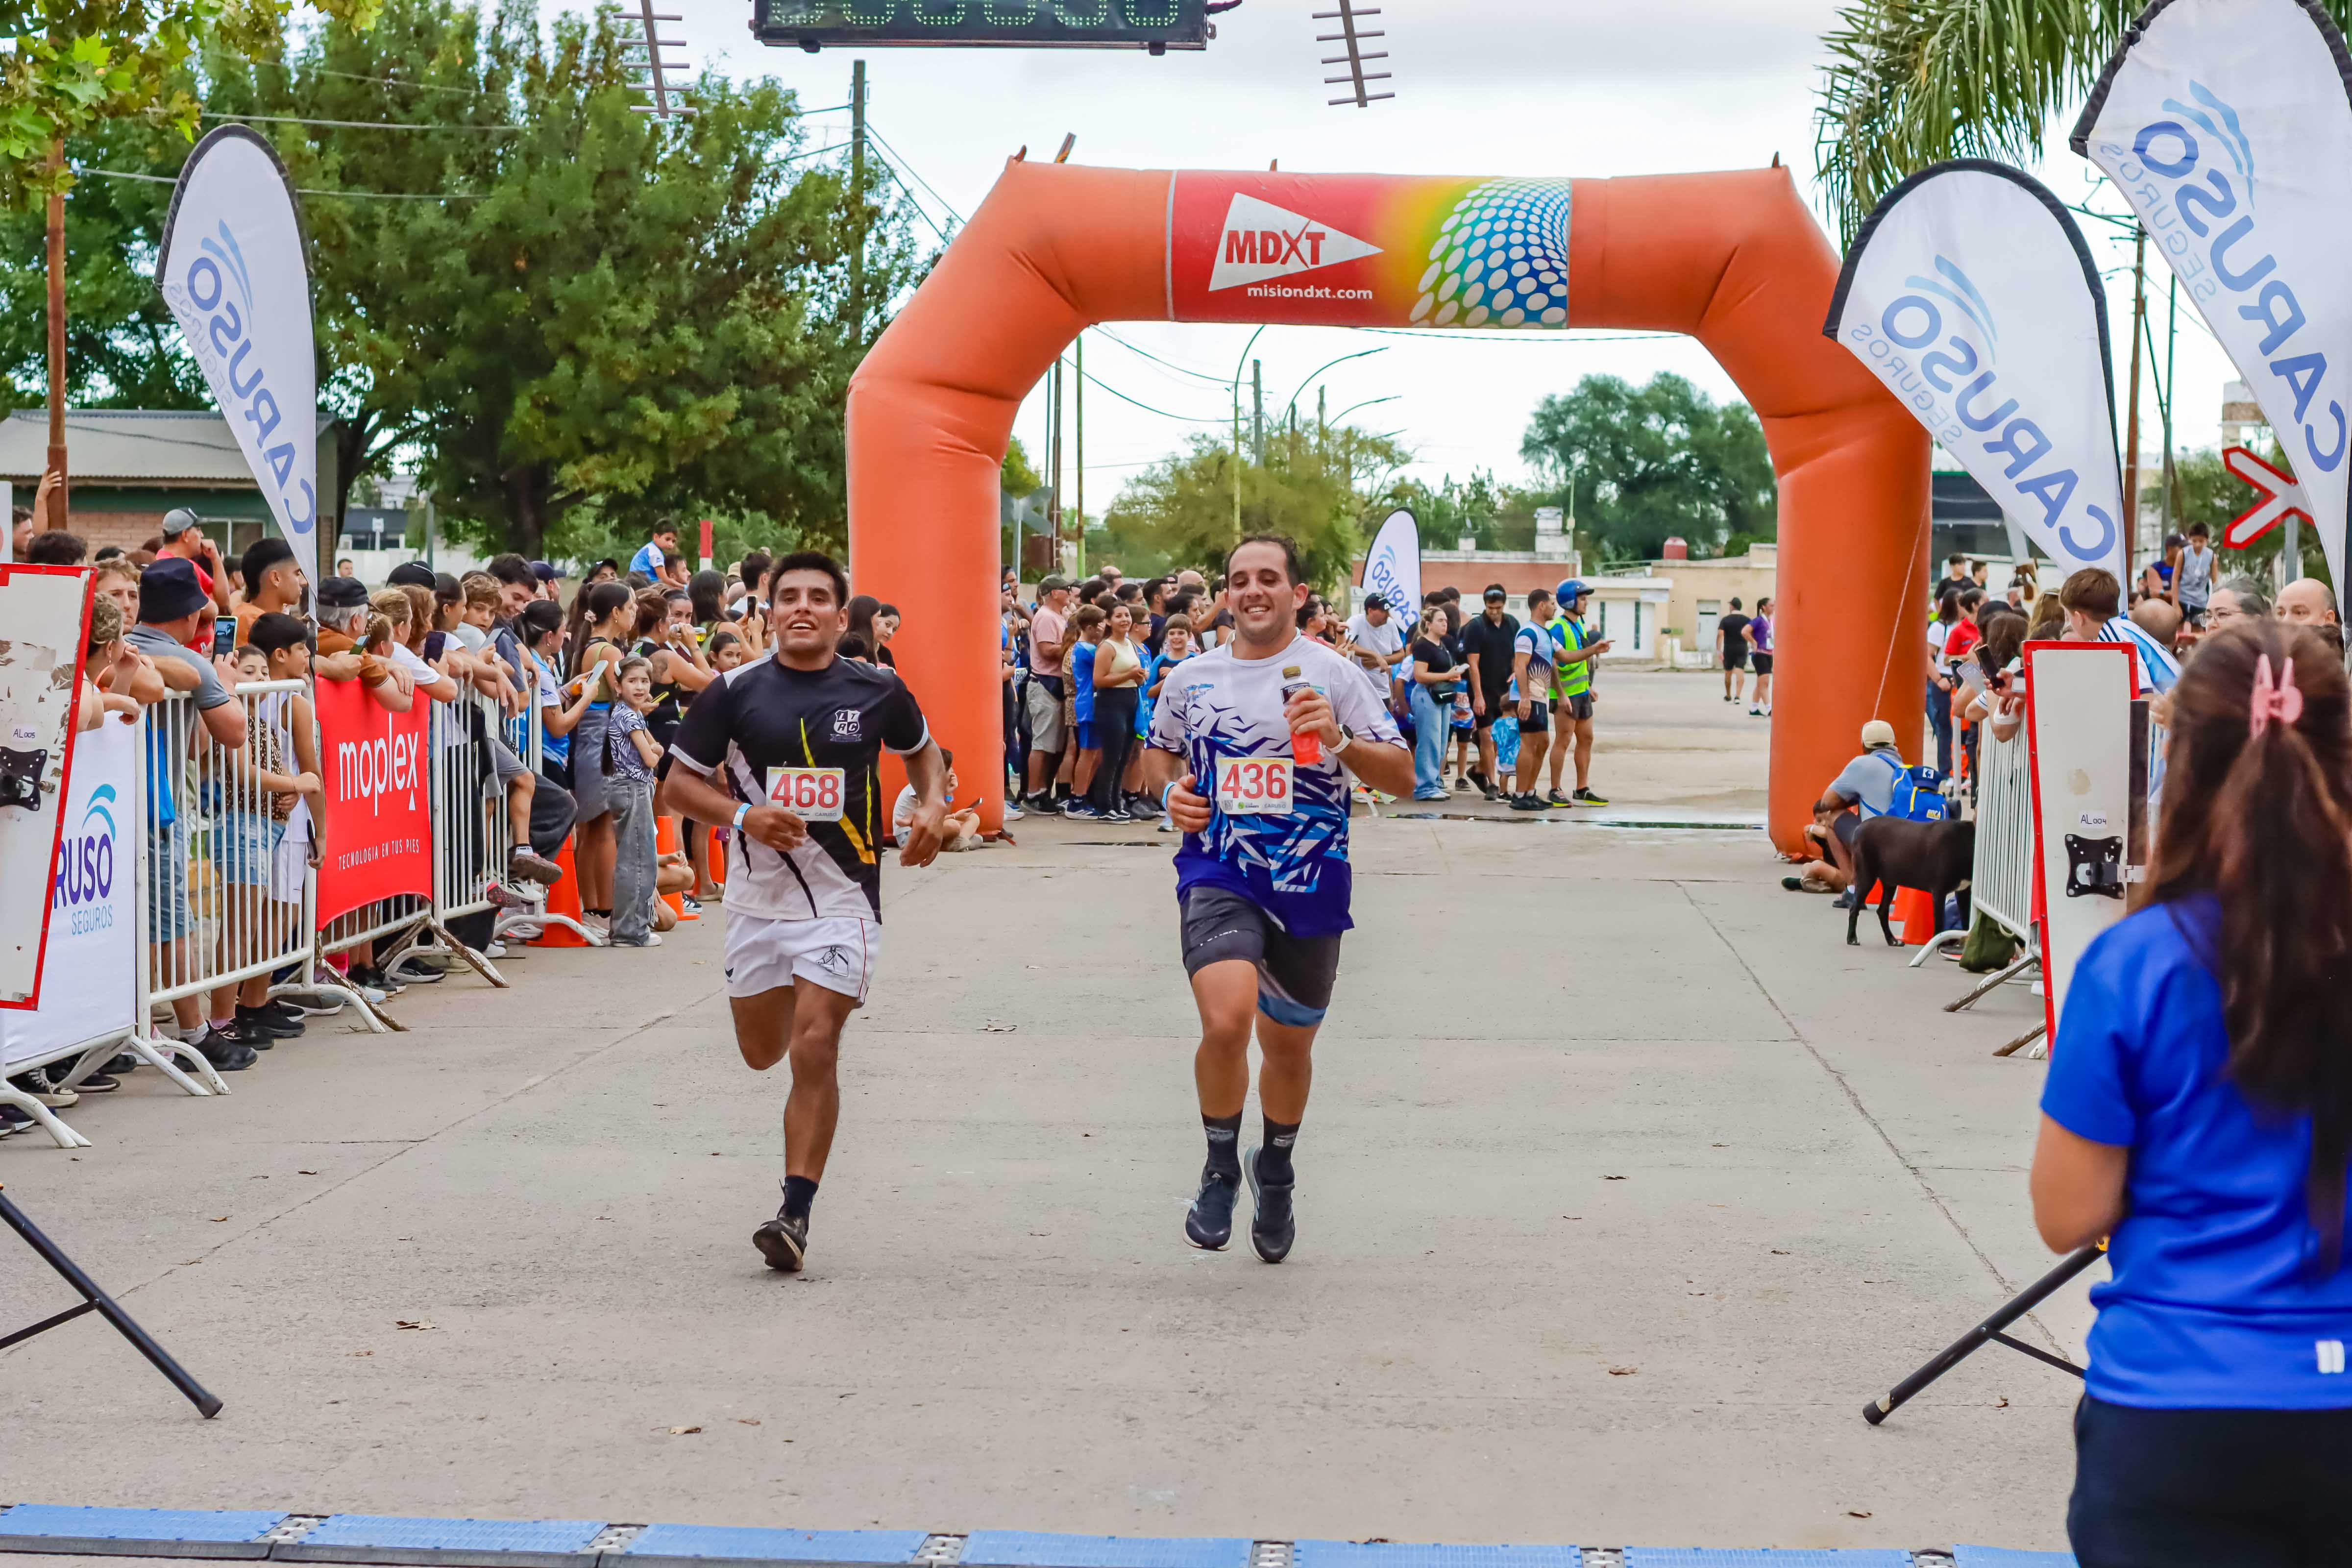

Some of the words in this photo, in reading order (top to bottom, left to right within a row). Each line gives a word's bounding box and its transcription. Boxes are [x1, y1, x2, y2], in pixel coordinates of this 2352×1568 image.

[1225, 220, 1325, 269] MDXT
[1248, 284, 1373, 299] misiondxt.com
[339, 712, 418, 816] moplex
[1222, 763, 1286, 799] 436
[771, 774, 839, 808] 468
[339, 845, 379, 871] TECNOLOGIA
[382, 842, 389, 858] EN
[392, 838, 402, 855] TUS
[406, 838, 419, 854] PIES
[72, 904, 113, 935] SEGUROS
